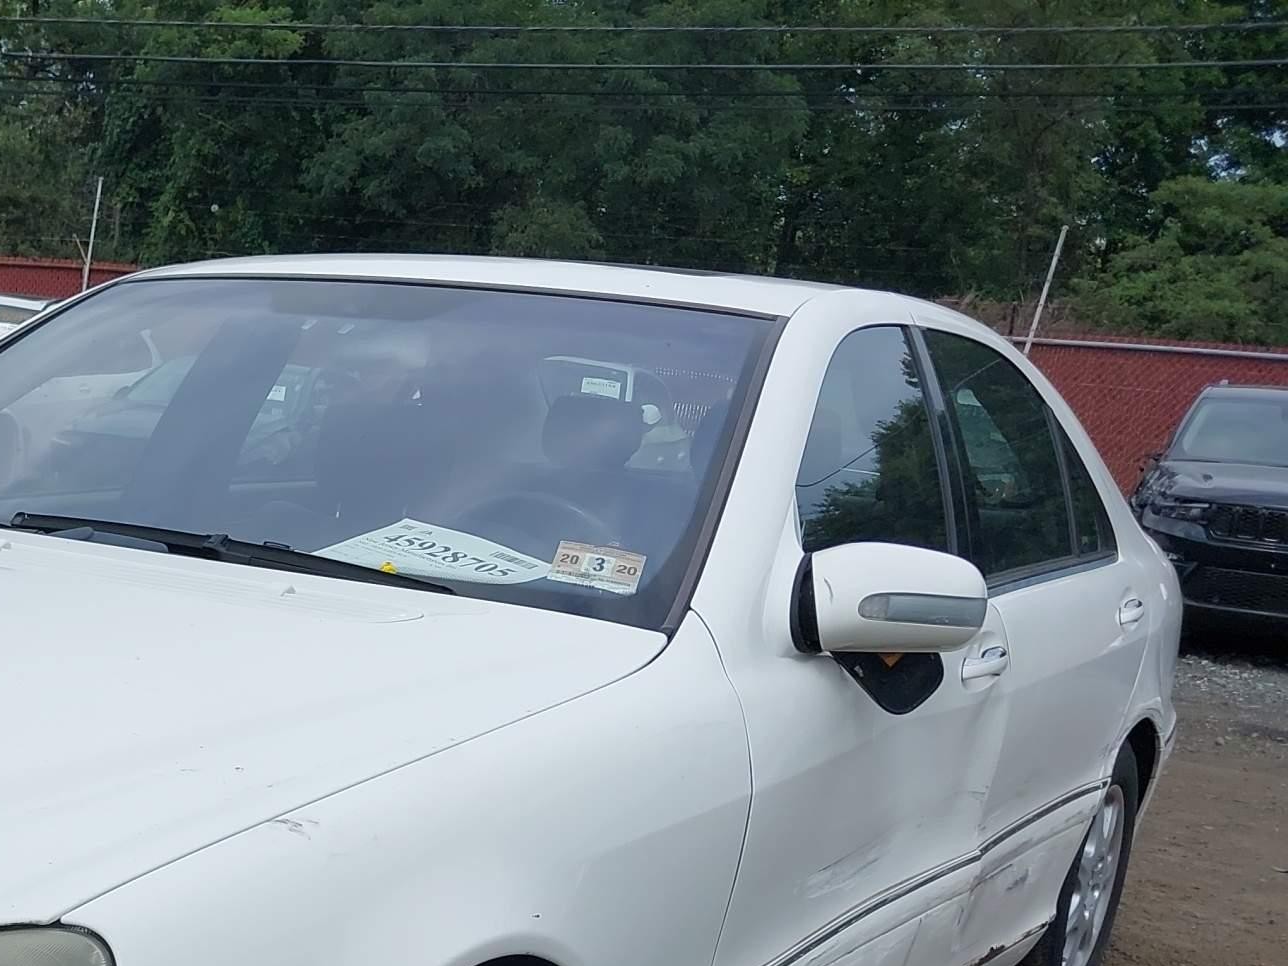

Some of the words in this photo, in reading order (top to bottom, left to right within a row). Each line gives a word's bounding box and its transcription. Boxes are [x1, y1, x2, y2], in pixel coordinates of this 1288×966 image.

[384, 534, 517, 577] 45928705
[559, 553, 580, 565] 20
[592, 557, 606, 572] 3
[615, 564, 638, 576] 20
